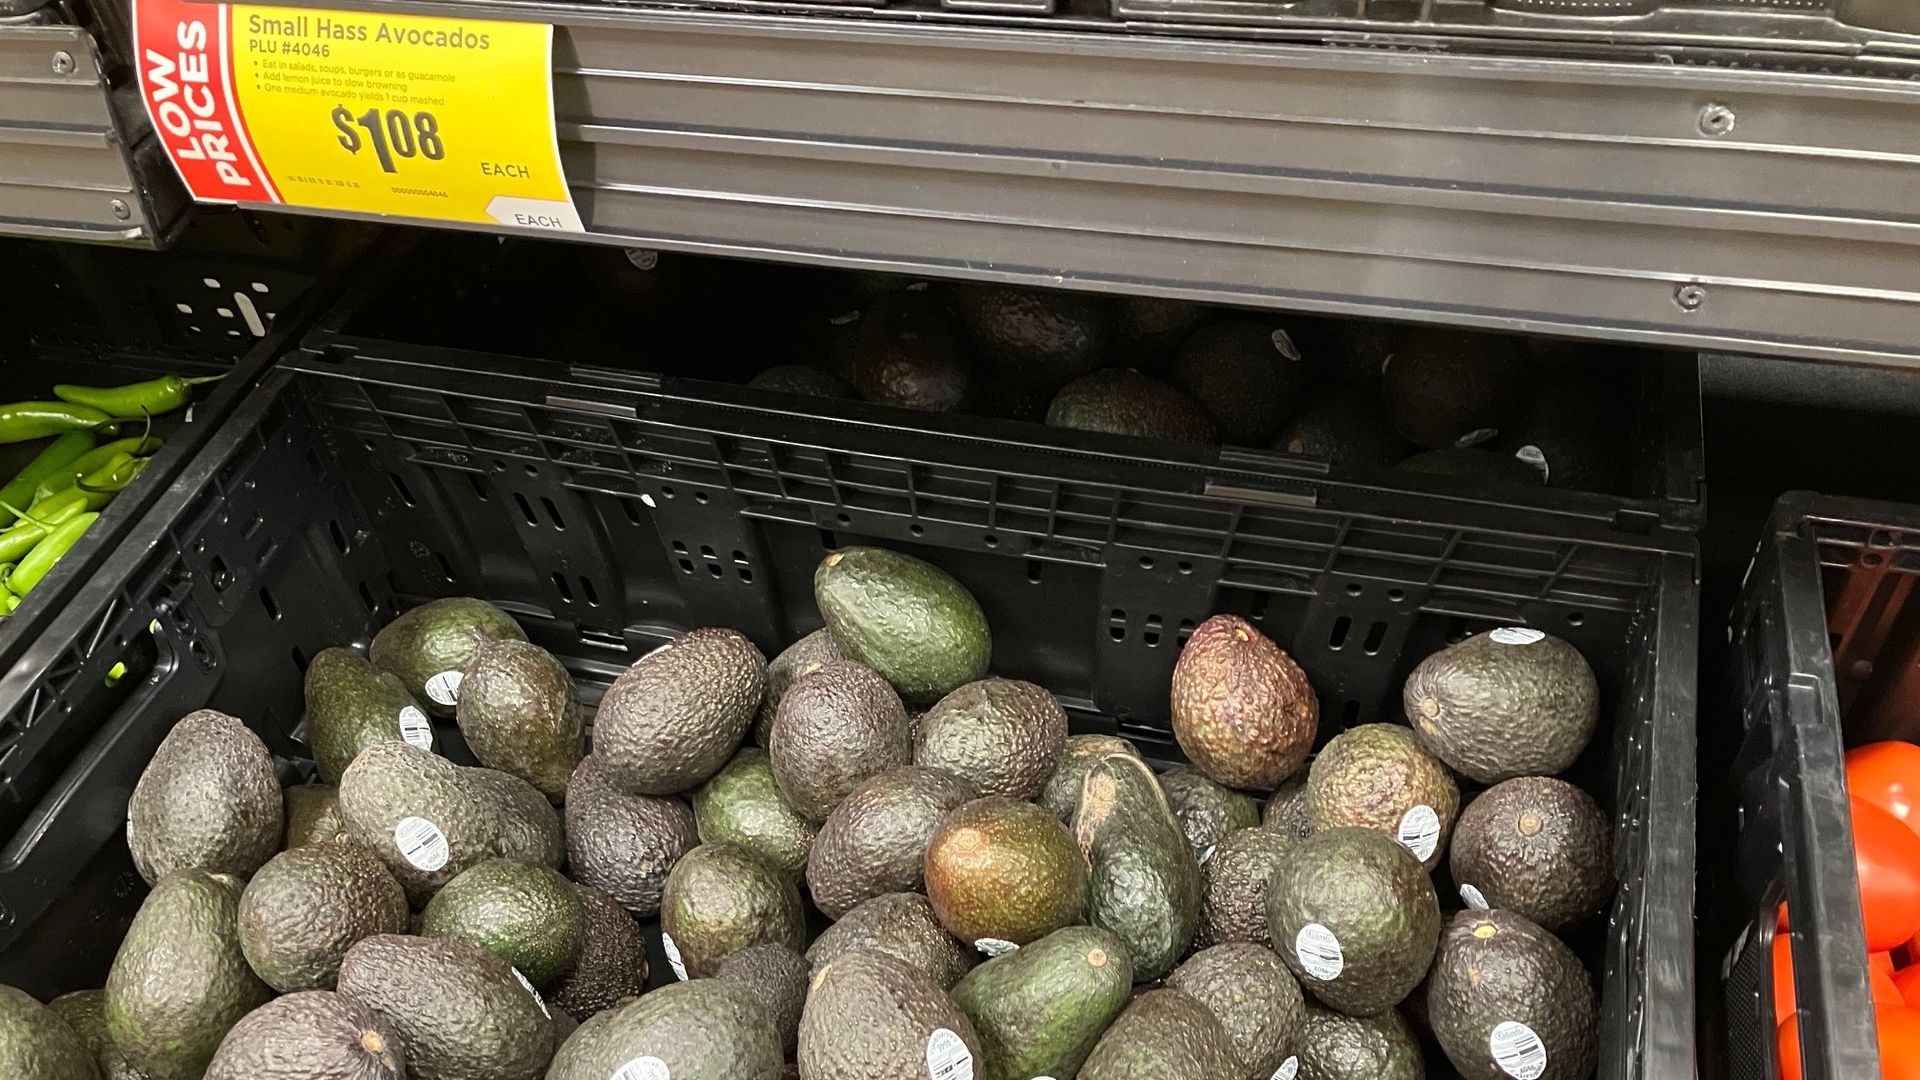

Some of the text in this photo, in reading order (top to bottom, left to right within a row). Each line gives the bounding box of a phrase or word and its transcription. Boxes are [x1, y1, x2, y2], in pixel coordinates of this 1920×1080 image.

[249, 14, 490, 50] Small Hass Avocados
[250, 40, 330, 57] PLU #4046
[262, 60, 276, 69] Eat
[279, 61, 287, 69] in
[289, 62, 317, 72] salads,
[320, 64, 346, 75] soups,
[349, 66, 382, 78] burgers
[396, 71, 406, 79] as
[408, 72, 456, 82] guacamole
[263, 72, 408, 93] Add lemon juice to slow browning
[146, 48, 206, 160] LOW
[177, 20, 252, 186] PRICES
[264, 83, 445, 106] One medium avocado yields 1 cup mashed
[481, 162, 530, 178] EACH
[515, 214, 562, 228] EACH
